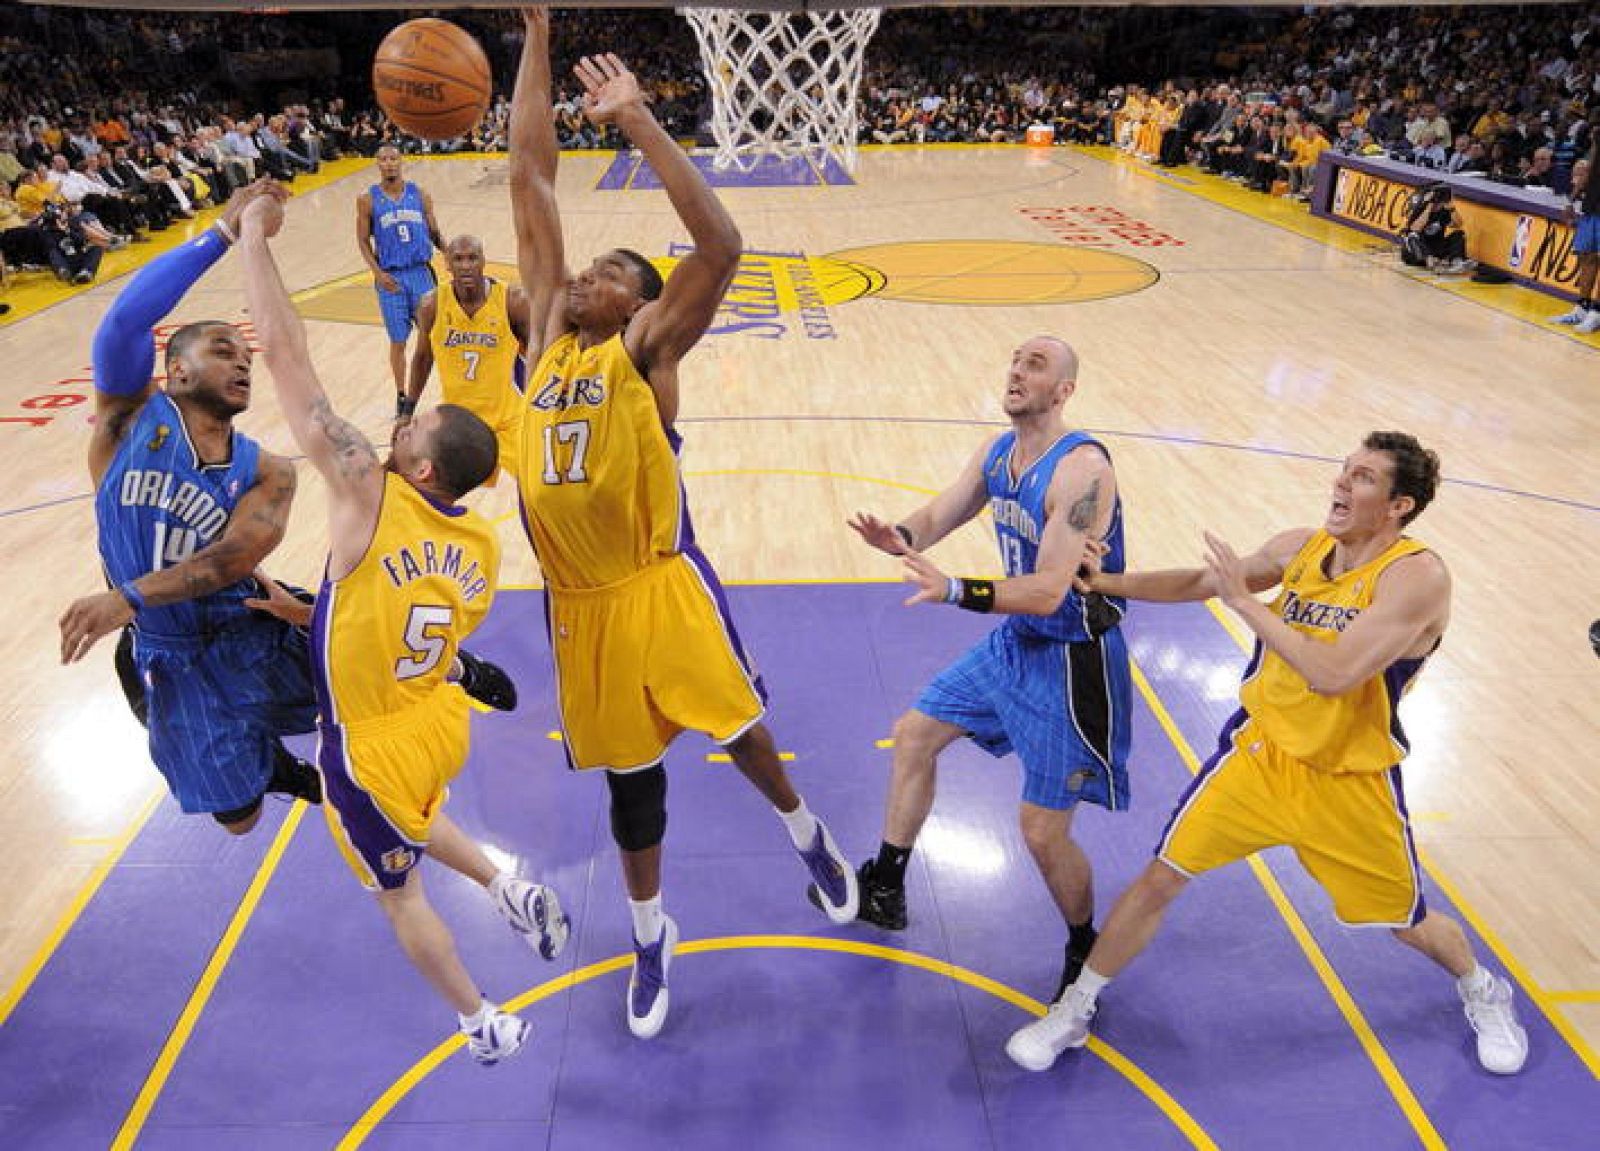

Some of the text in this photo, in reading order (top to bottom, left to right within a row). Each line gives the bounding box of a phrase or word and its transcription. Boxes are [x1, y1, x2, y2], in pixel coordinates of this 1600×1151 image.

[1346, 176, 1389, 224] NBA
[399, 224, 410, 242] 9
[445, 328, 497, 347] LAKERS
[463, 350, 480, 380] 7
[542, 419, 591, 485] 17
[121, 468, 228, 540] ORLAND
[153, 521, 197, 571] 14
[1001, 532, 1022, 576] 13
[383, 540, 486, 602] FARMAR
[394, 603, 453, 682] 5
